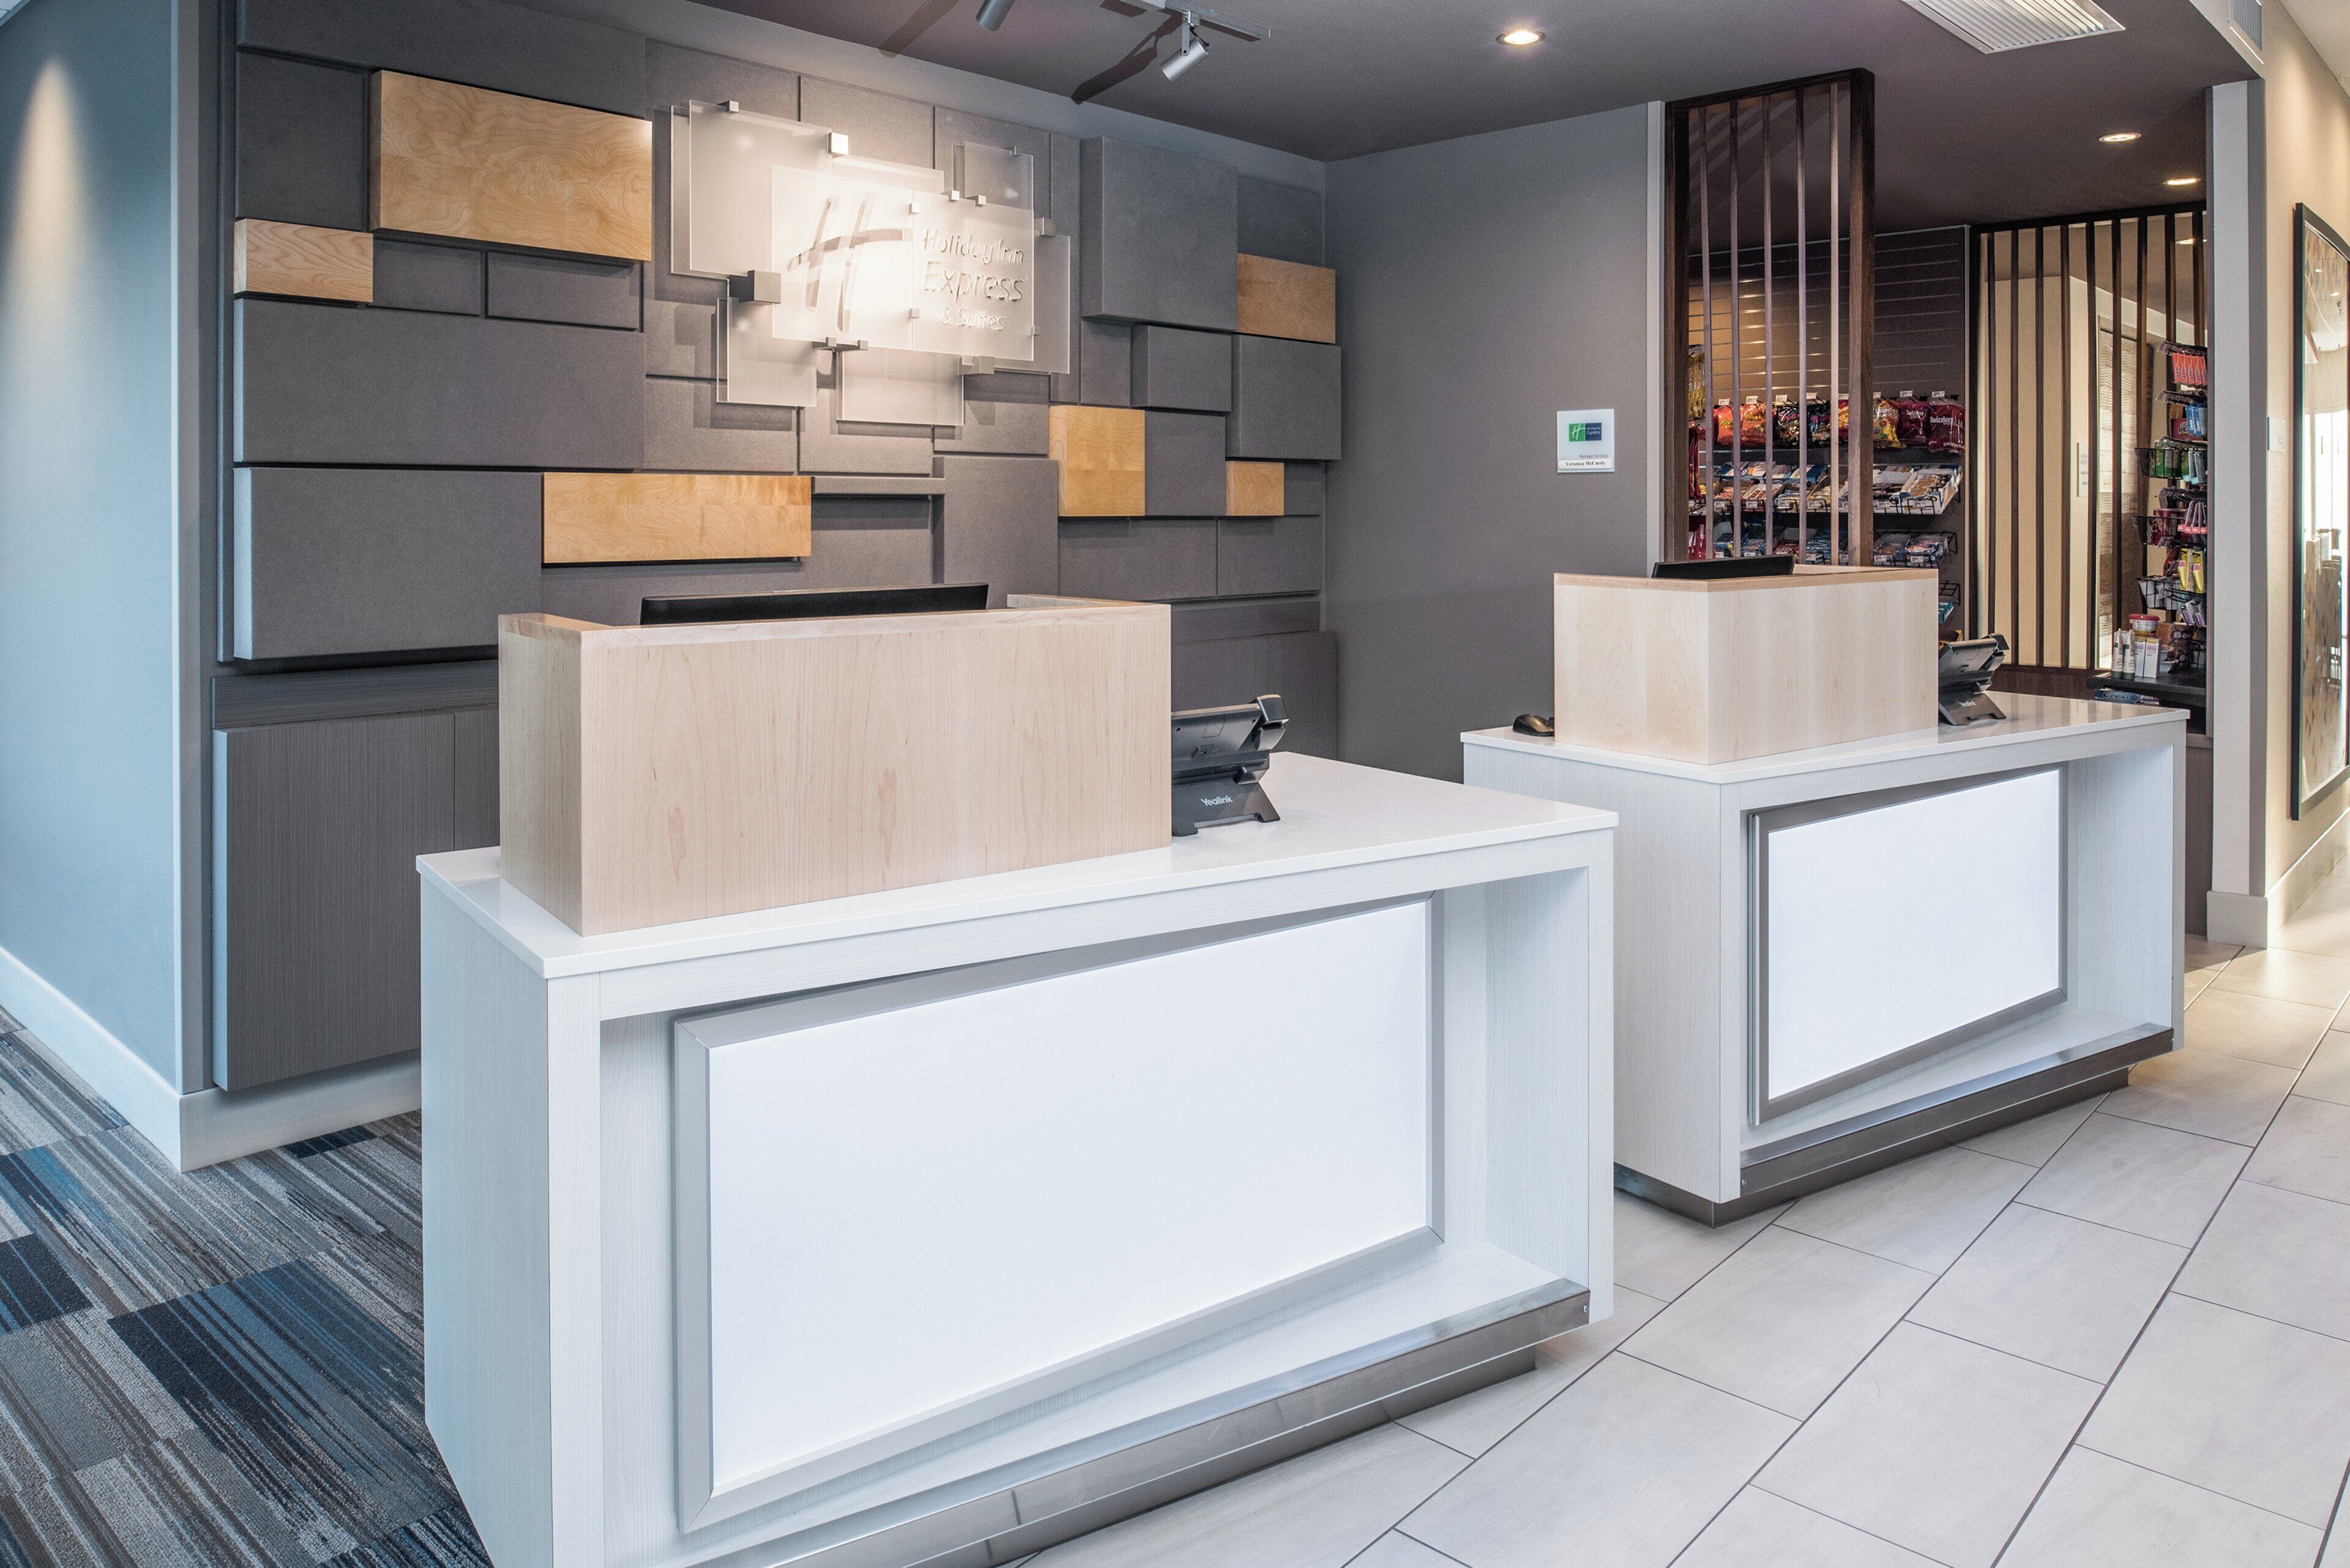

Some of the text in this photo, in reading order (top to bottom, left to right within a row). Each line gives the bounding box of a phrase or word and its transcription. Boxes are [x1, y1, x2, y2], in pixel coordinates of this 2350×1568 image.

[923, 228, 1024, 264] Holiday Inn
[922, 259, 1024, 304] Express
[941, 306, 1005, 331] & Suites
[1200, 795, 1233, 806] Yealink
